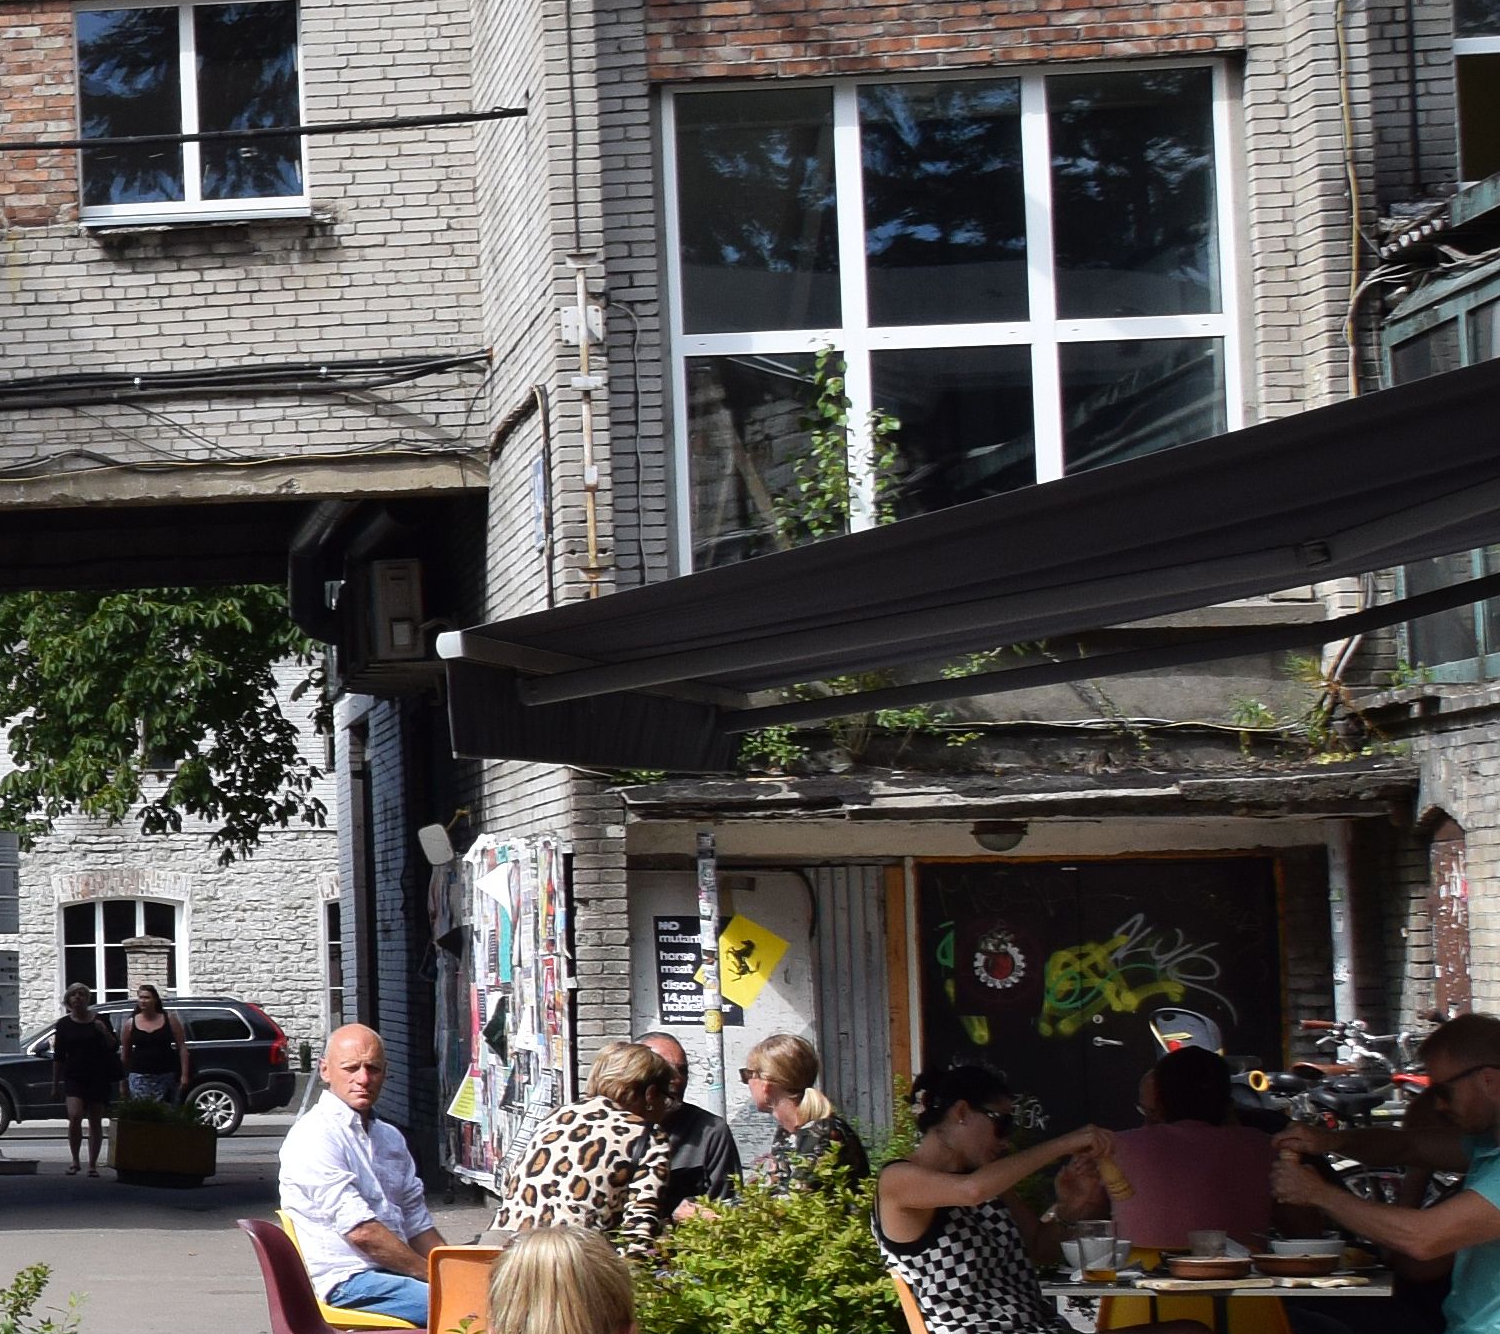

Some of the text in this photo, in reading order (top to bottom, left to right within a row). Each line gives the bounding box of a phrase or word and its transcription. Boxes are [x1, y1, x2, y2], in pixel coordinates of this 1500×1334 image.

[659, 950, 696, 961] horse
[660, 964, 694, 974] meat
[661, 979, 696, 991] disco
